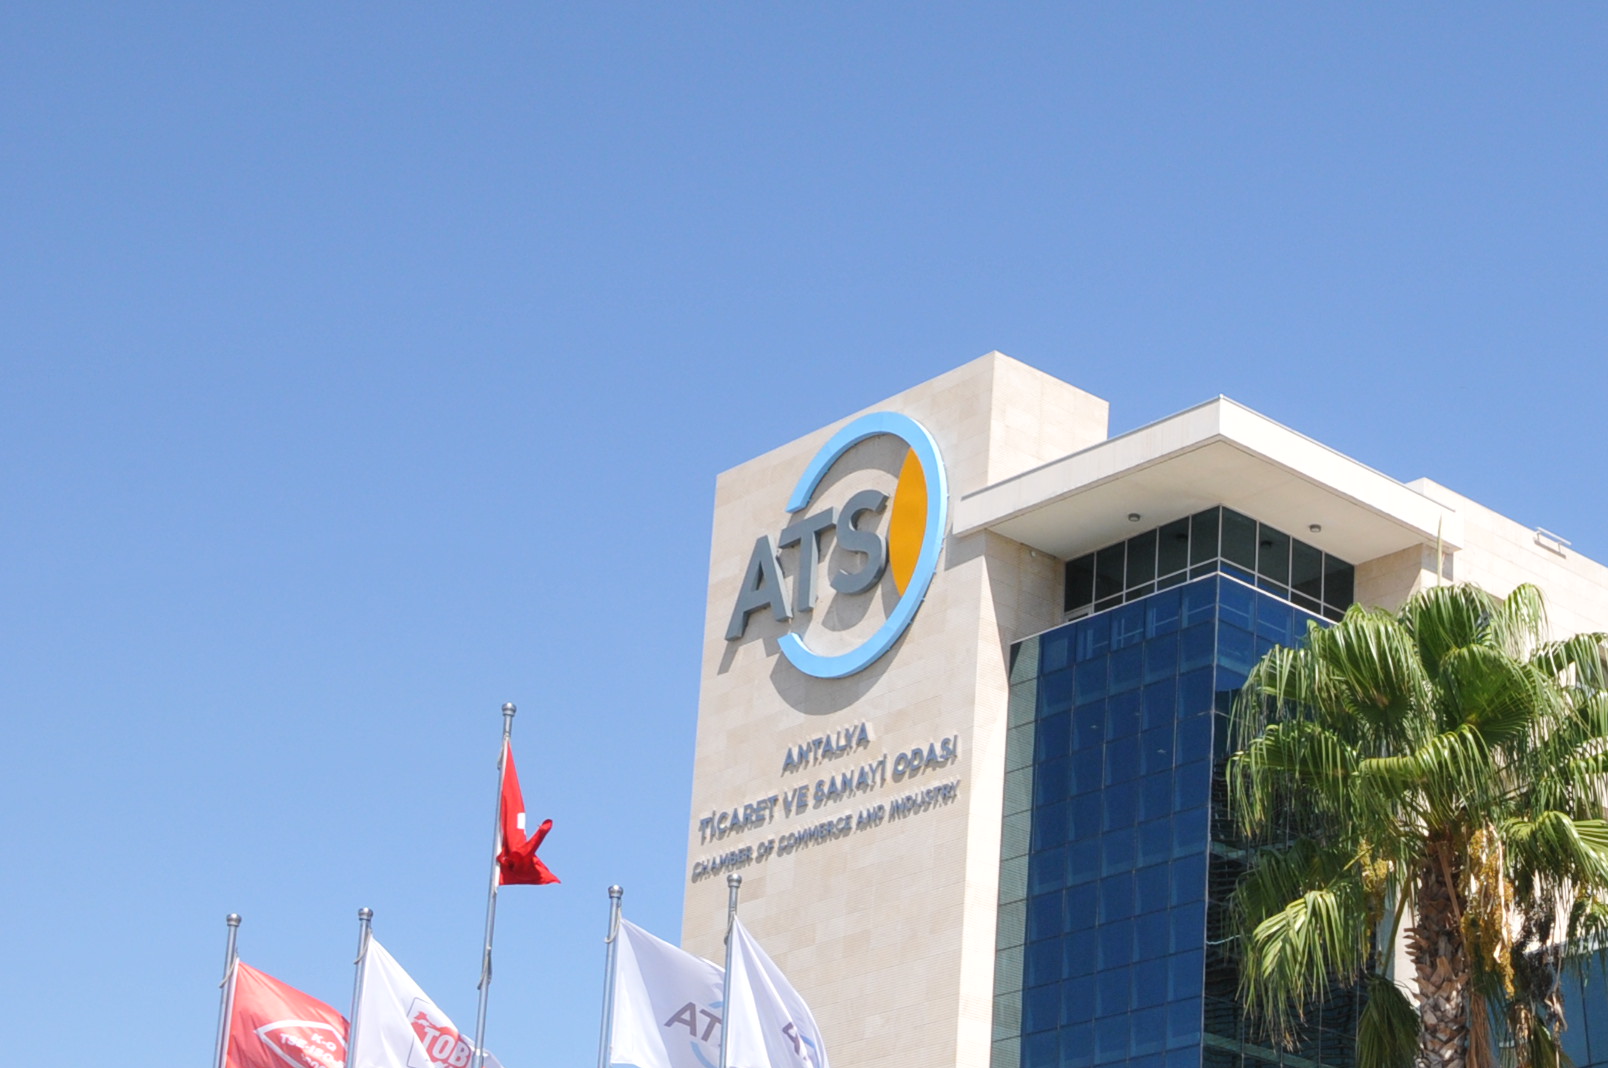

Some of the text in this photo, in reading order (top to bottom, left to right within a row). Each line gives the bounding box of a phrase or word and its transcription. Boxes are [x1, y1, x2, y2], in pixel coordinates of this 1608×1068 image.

[725, 489, 889, 641] ATS
[700, 735, 958, 840] TİCARET VE SANAYİ ODASI
[783, 722, 871, 772] ANTALYA
[692, 779, 961, 880] CHAMBER OF COMMERCE AND INDUSTRY
